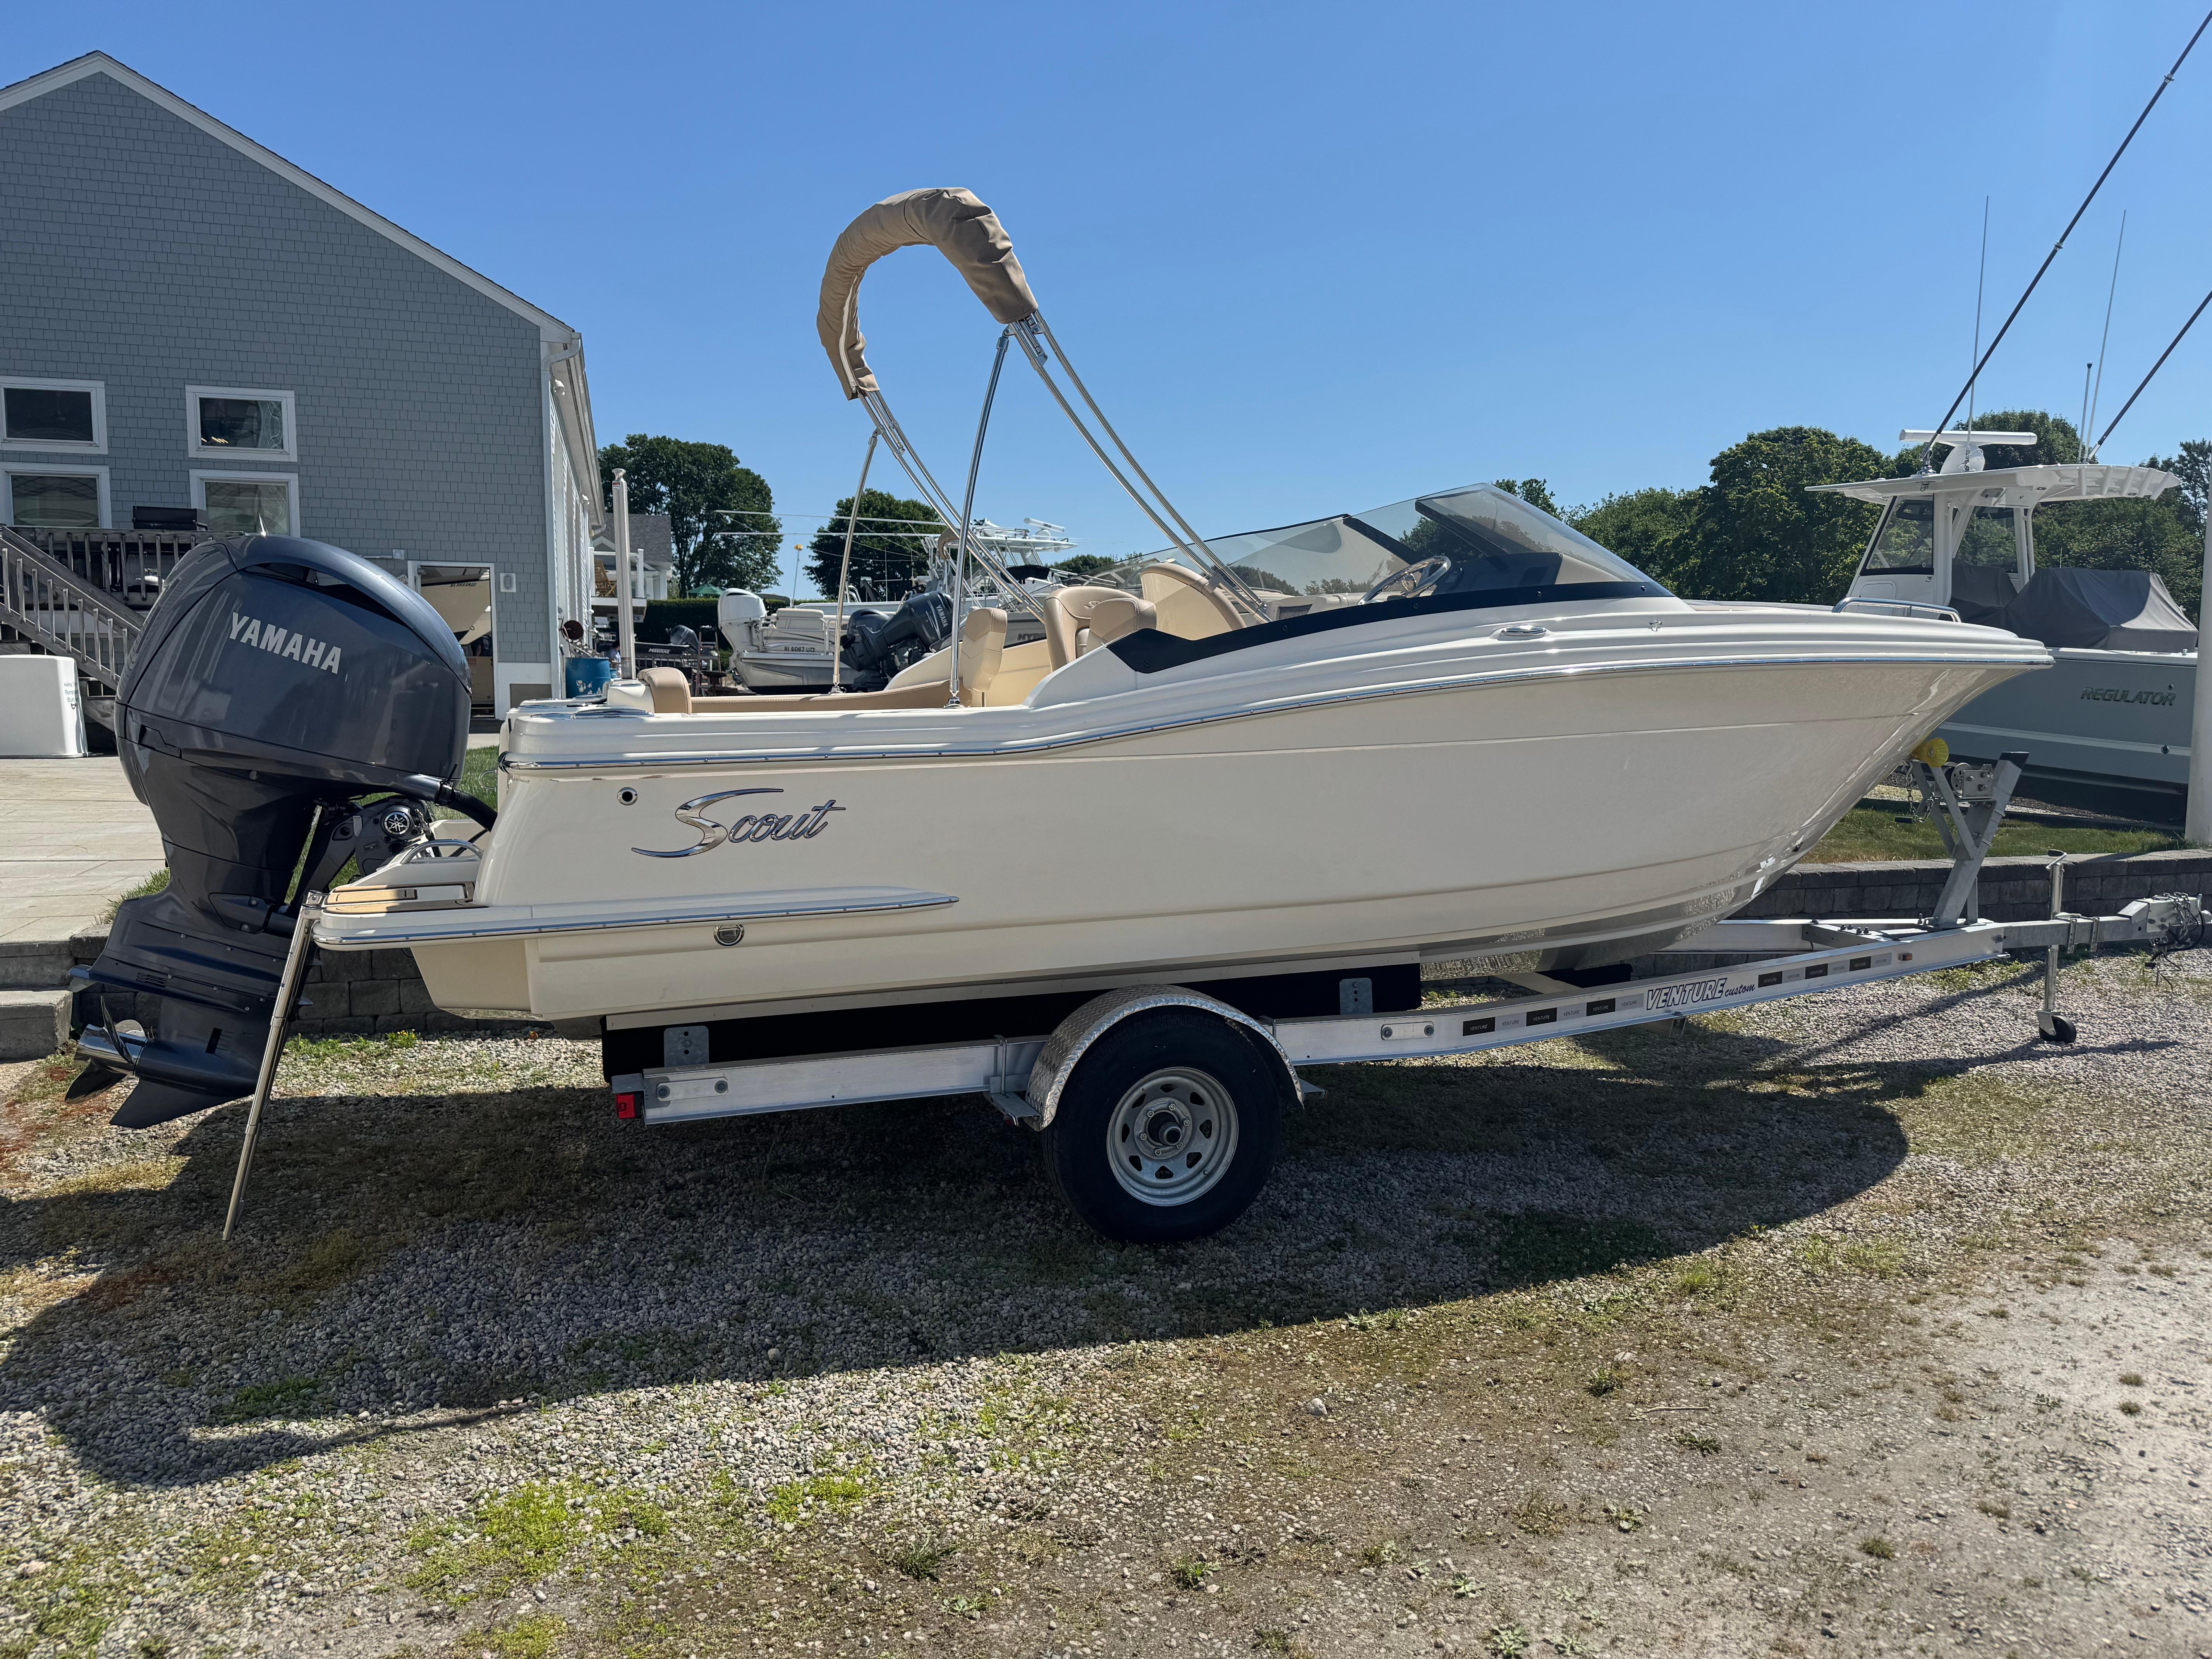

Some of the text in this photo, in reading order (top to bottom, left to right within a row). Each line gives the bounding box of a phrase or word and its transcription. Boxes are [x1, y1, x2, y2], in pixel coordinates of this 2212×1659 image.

[936, 605, 948, 627] YAMAHA
[229, 612, 341, 674] YAMAHA
[2080, 687, 2176, 706] REGULATOR
[631, 788, 847, 858] Scout
[1646, 977, 1755, 1010] VENTURE custom
